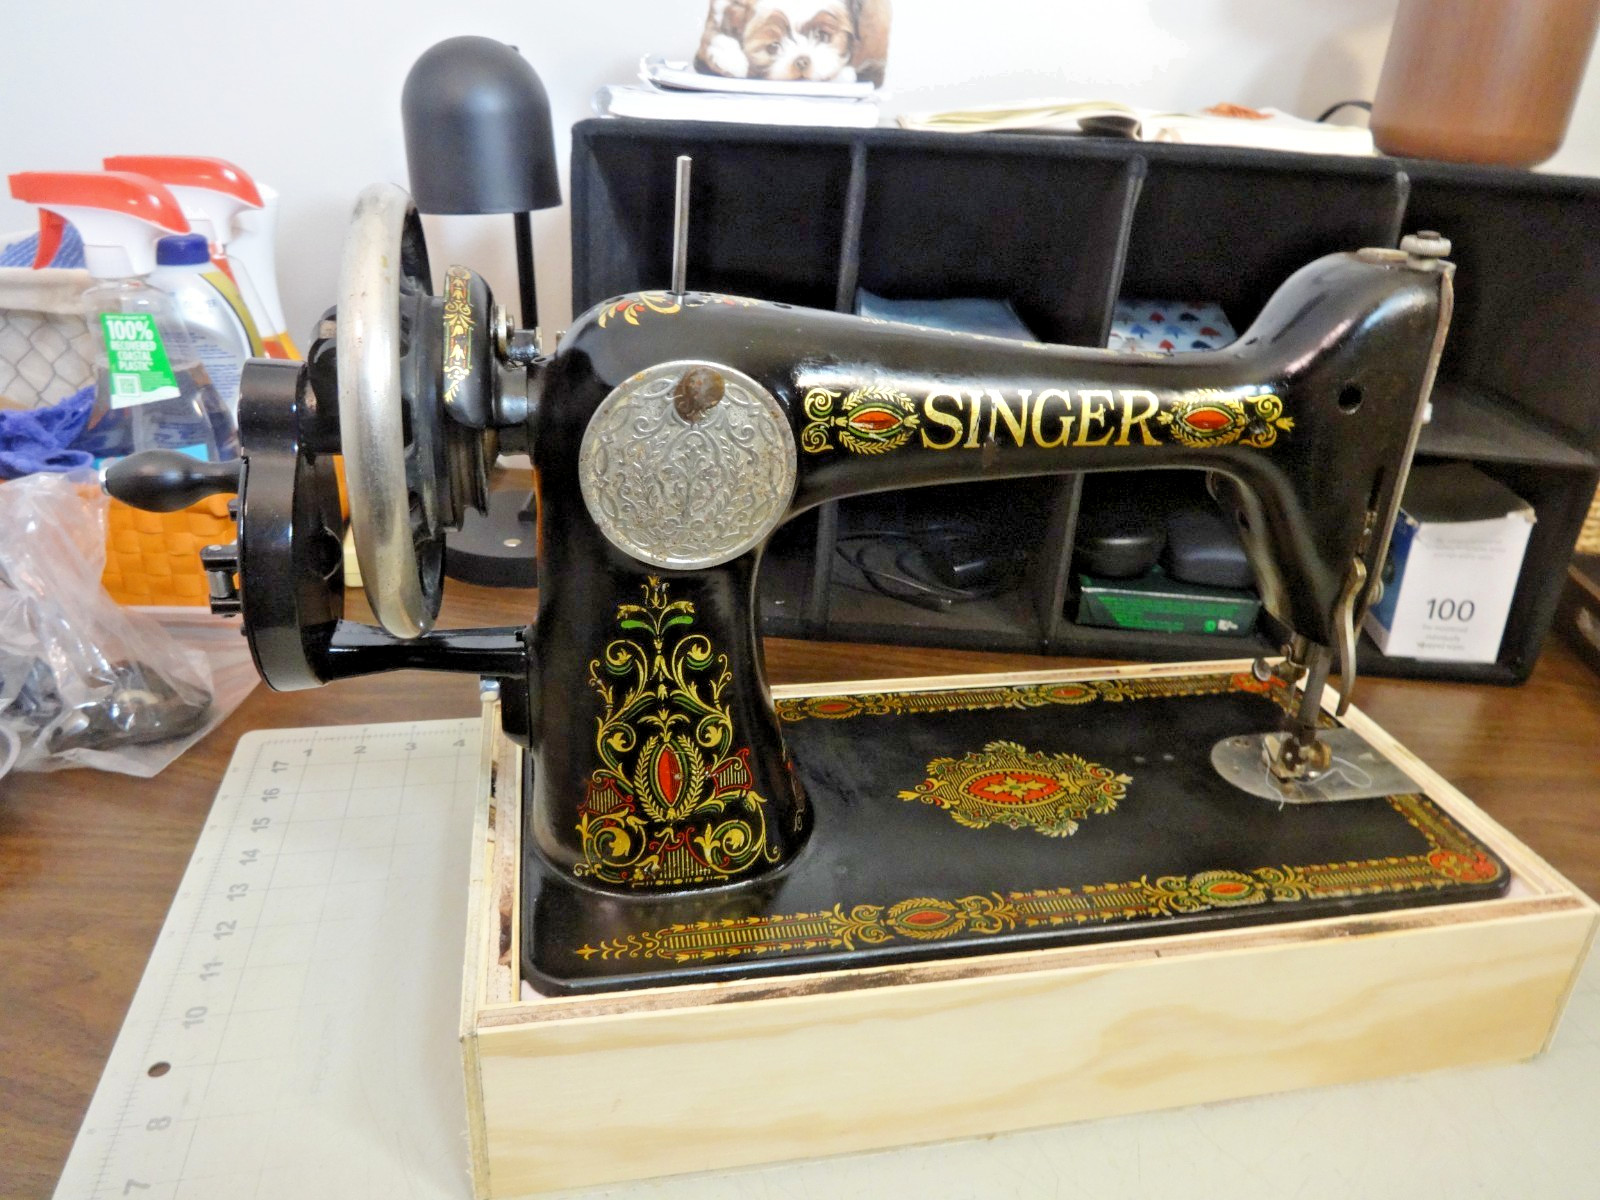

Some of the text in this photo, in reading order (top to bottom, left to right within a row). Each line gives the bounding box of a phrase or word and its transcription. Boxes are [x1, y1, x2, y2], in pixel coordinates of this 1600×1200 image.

[106, 320, 154, 340] 100%
[110, 341, 157, 351] RECOVERED
[117, 351, 152, 361] COASTAL
[921, 389, 1162, 449] SINGER
[1426, 598, 1476, 622] 100
[353, 745, 367, 754] 2
[404, 742, 417, 751] 3
[452, 738, 466, 748] 4
[122, 760, 290, 1196] 7 8 10 11 12 13 14 15 16 17
